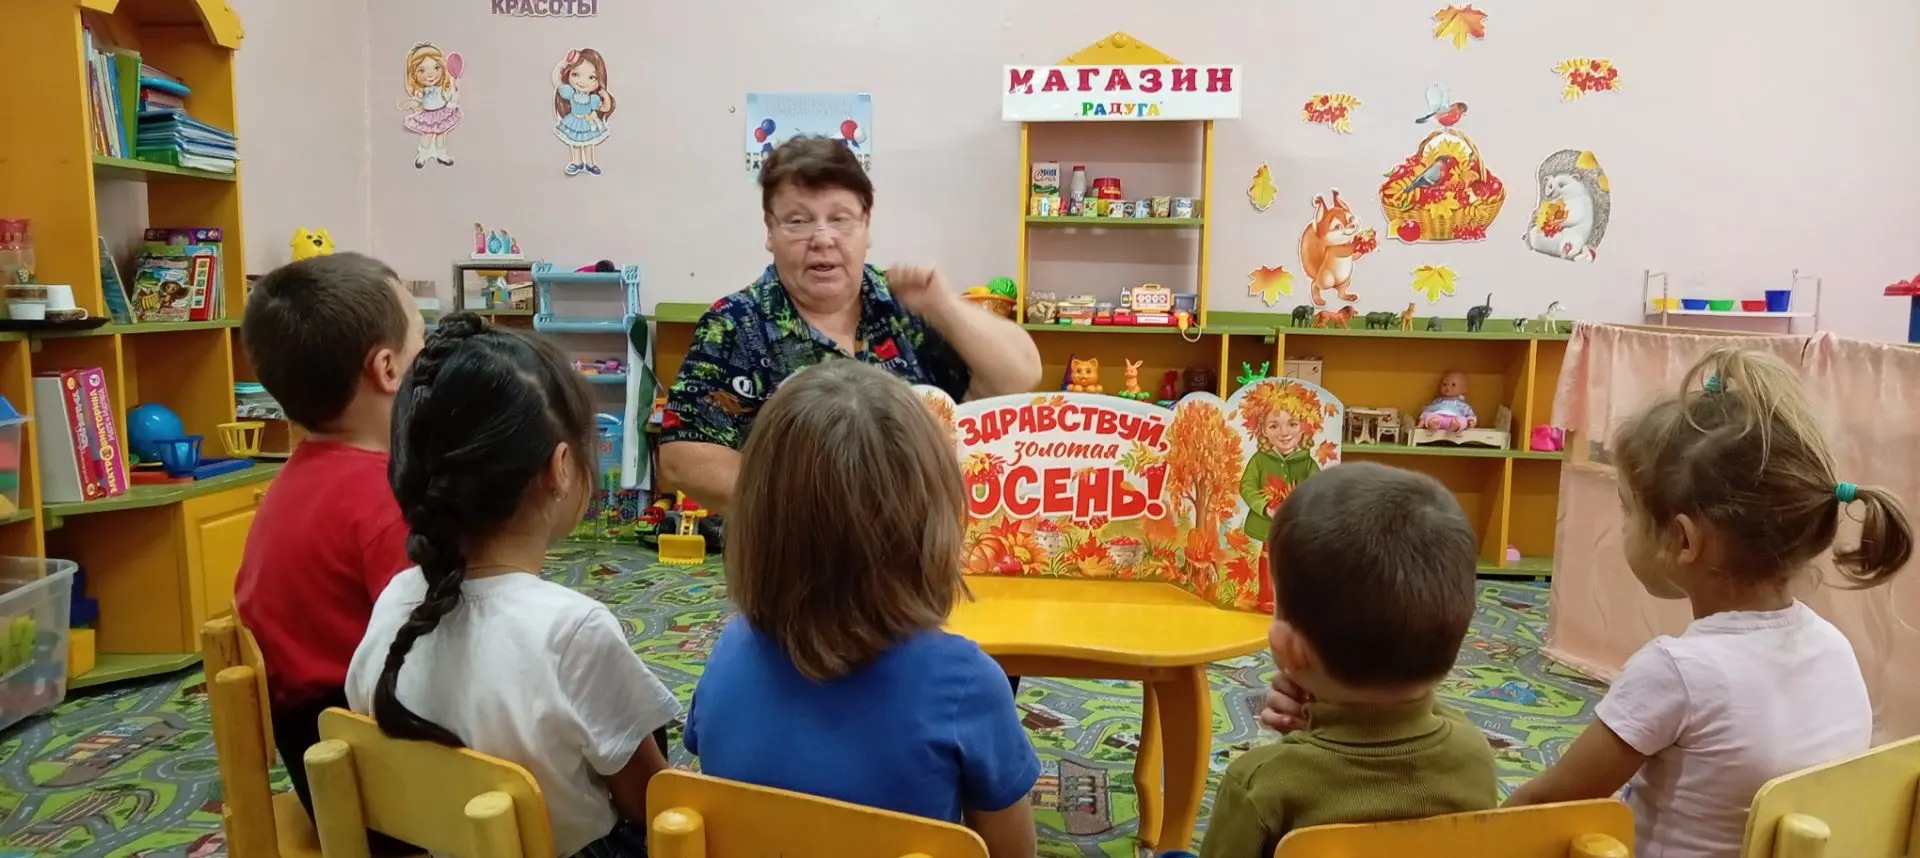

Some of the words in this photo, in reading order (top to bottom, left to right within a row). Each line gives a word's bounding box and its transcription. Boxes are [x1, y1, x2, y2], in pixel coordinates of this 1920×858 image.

[491, 0, 597, 14] КРАСОТЫ
[1009, 68, 1233, 94] МАГАЗИН
[958, 404, 1170, 452] ЗДРАВСТВУЙ,
[1007, 440, 1120, 466] золотая
[966, 462, 1168, 518] ОСЕНЬ!
